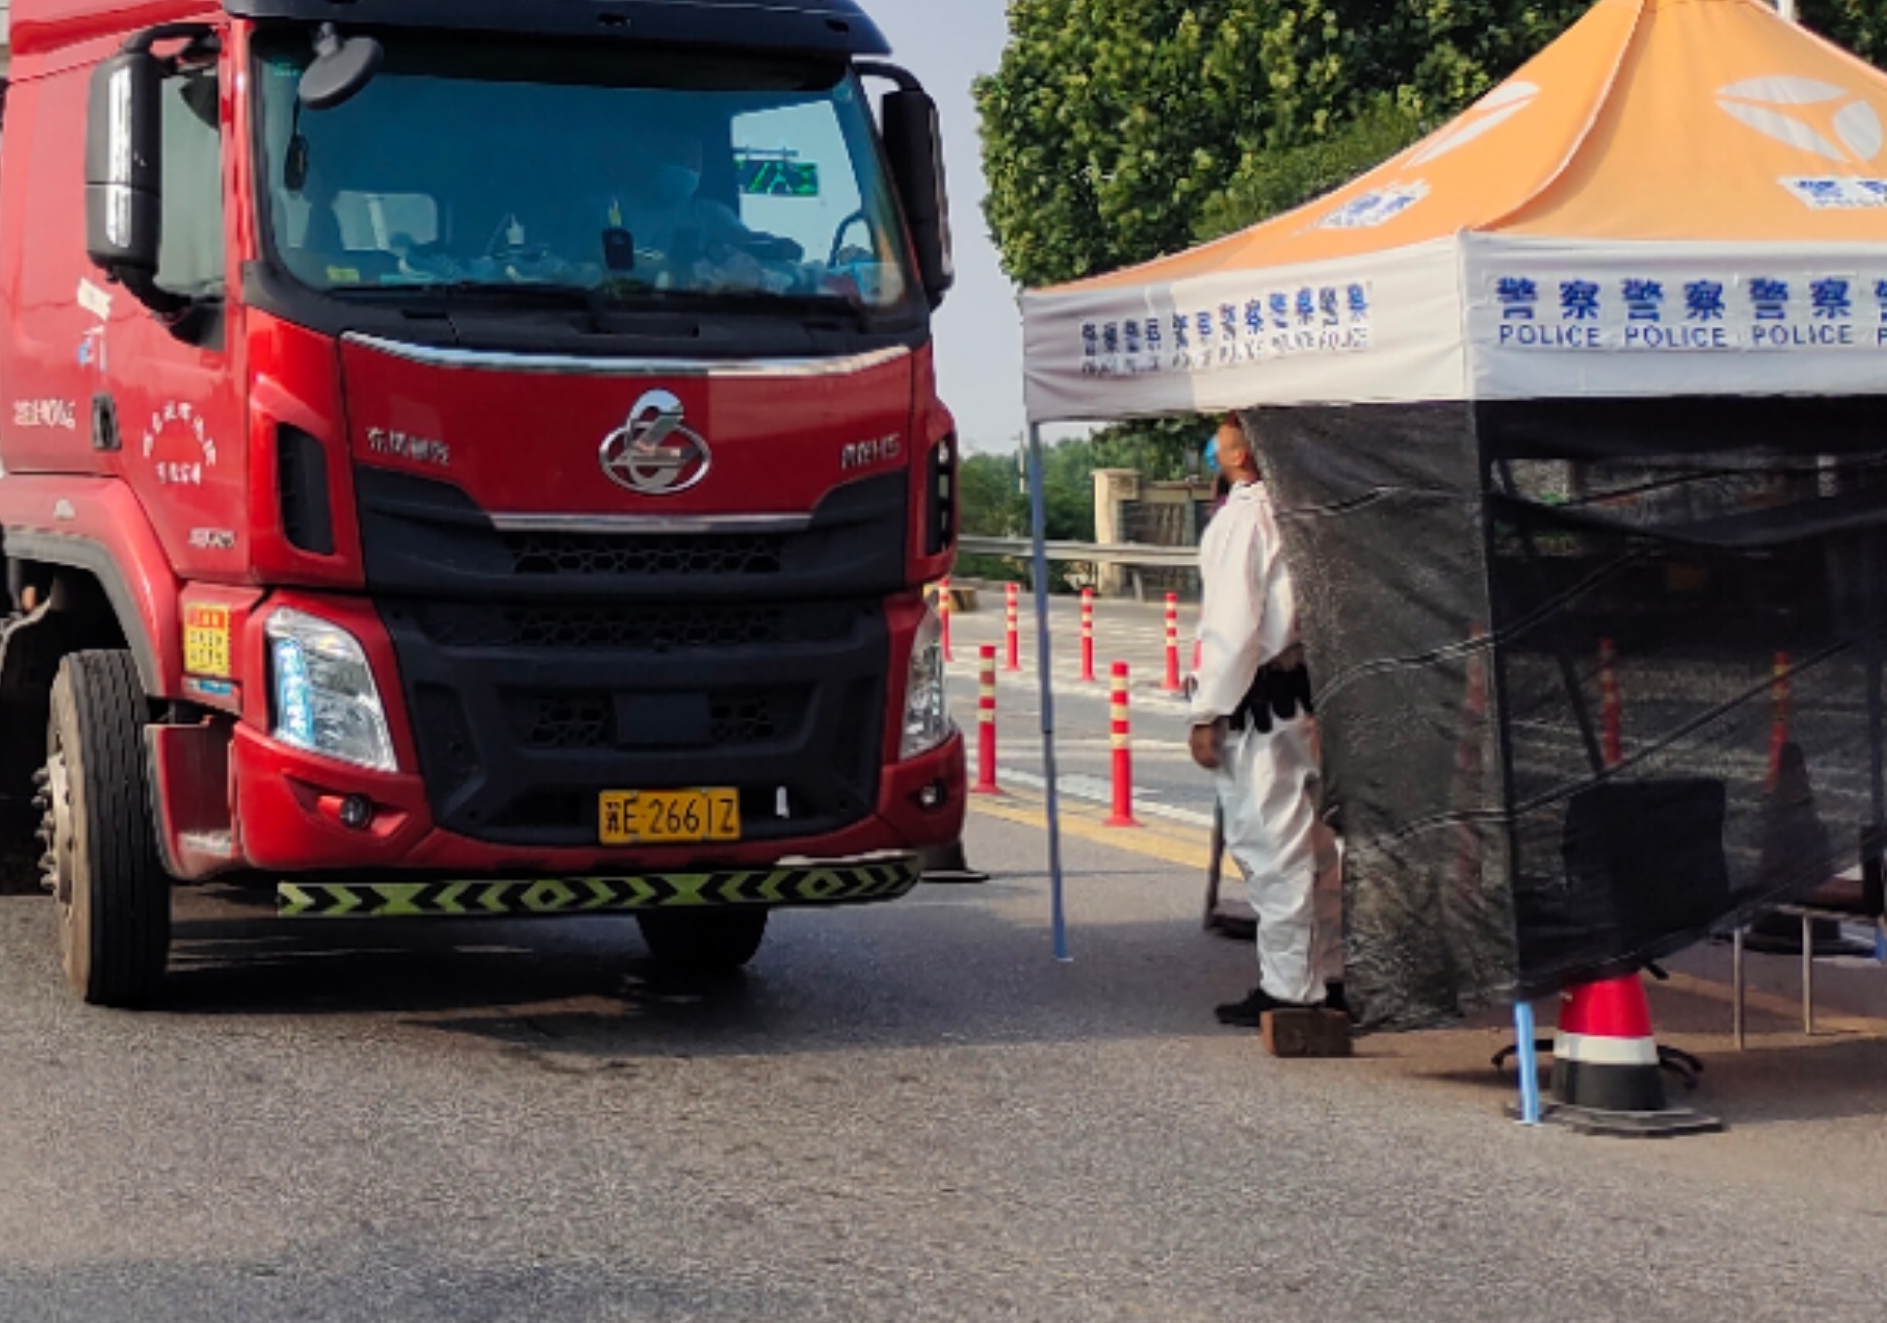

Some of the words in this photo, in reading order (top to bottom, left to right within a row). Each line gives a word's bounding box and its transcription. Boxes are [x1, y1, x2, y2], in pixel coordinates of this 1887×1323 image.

[1499, 324, 1602, 347] POLICE
[1625, 325, 1727, 347] POLICE
[1752, 325, 1854, 345] POLICE
